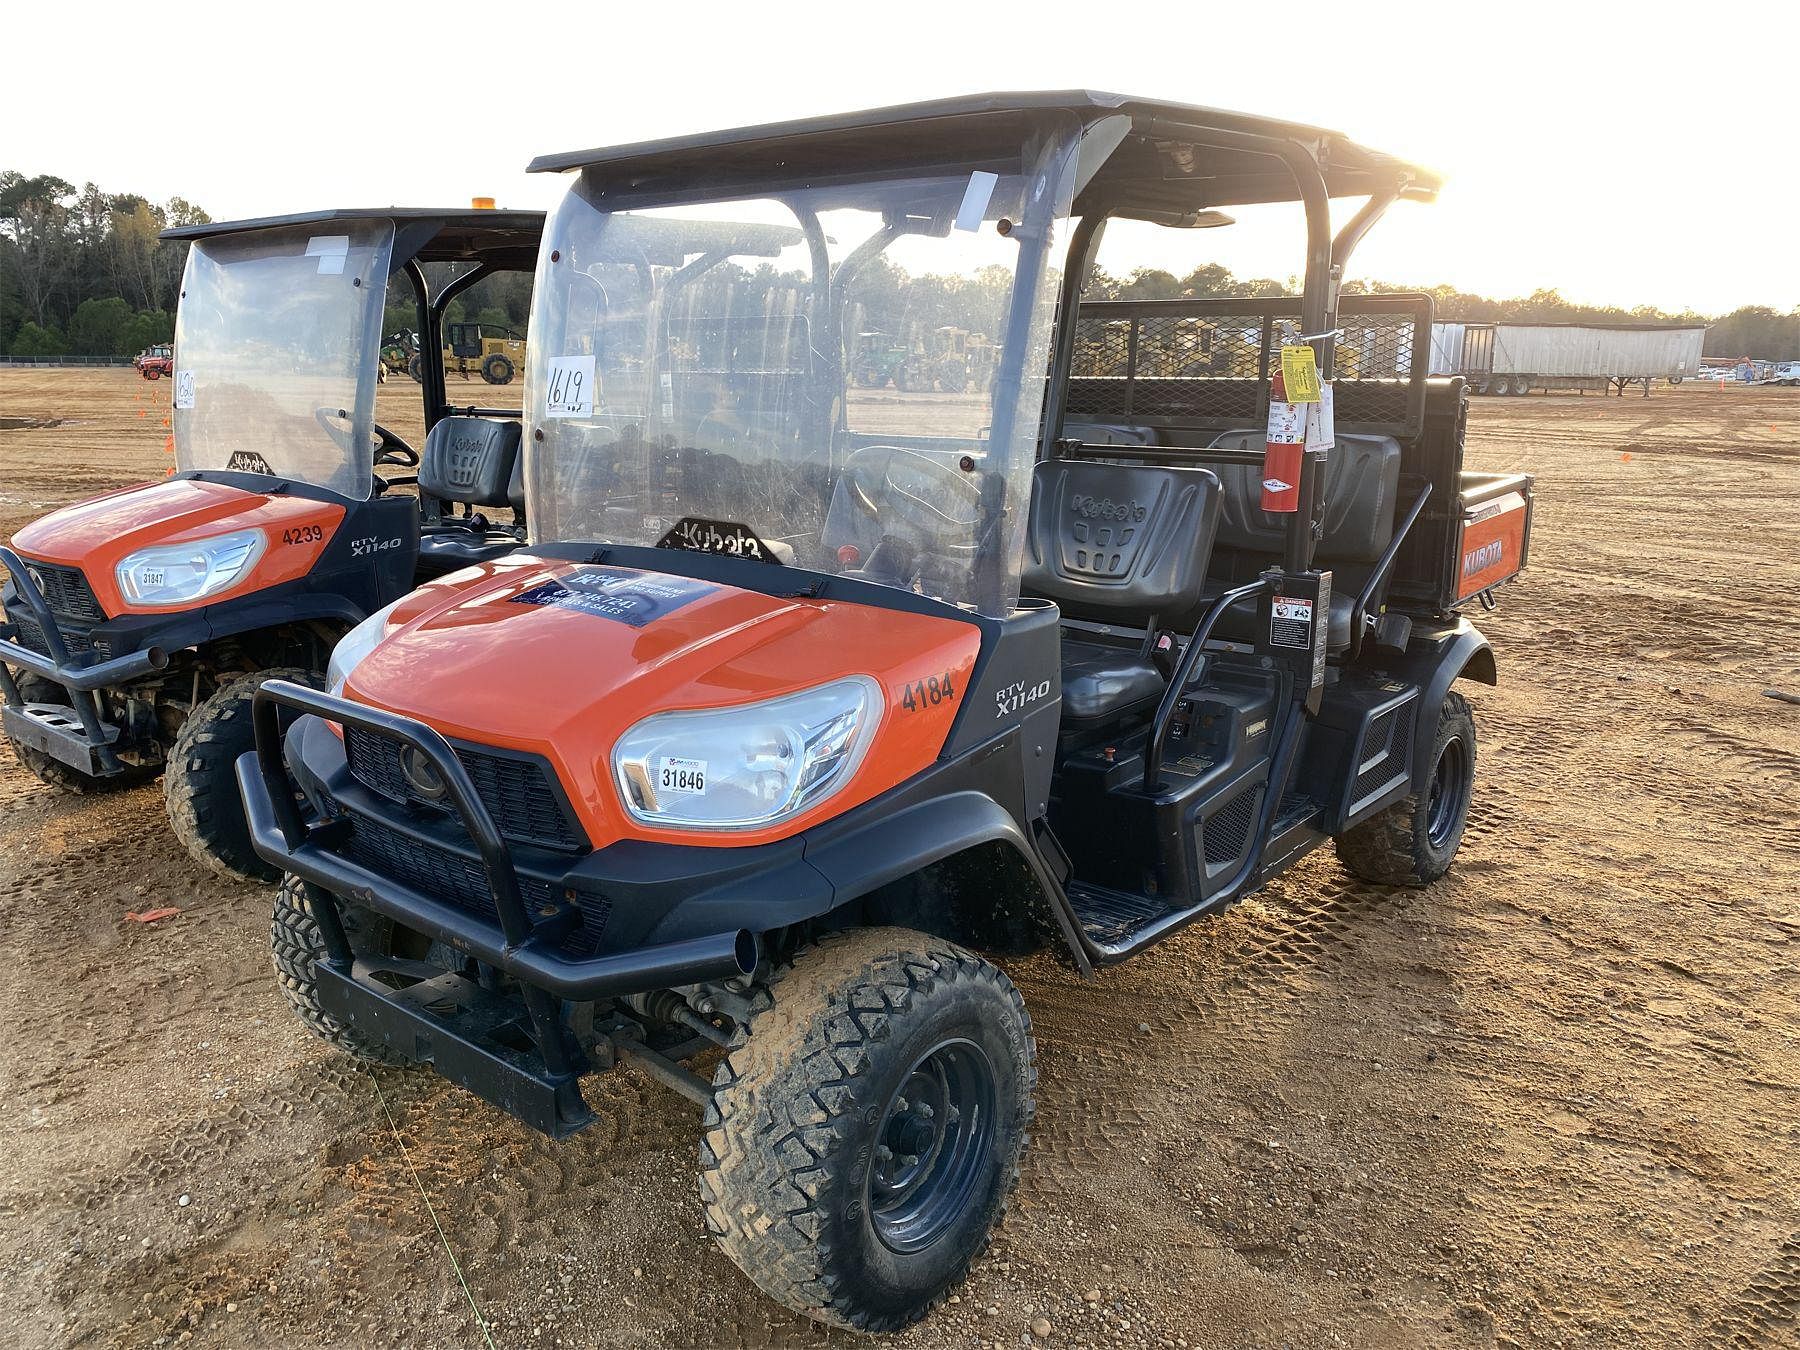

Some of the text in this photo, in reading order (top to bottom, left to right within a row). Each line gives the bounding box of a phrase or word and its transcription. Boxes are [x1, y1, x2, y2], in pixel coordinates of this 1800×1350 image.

[547, 367, 583, 403] 1619
[1071, 494, 1147, 523] Kubota
[283, 525, 323, 546] 4239
[352, 535, 377, 547] RTV
[352, 537, 402, 557] X1140
[1463, 539, 1503, 579] KUBOTA
[143, 573, 163, 584] 31847
[902, 671, 954, 712] 4184
[995, 680, 1025, 701] RTV
[995, 680, 1050, 718] X1140
[662, 768, 704, 790] 31846
